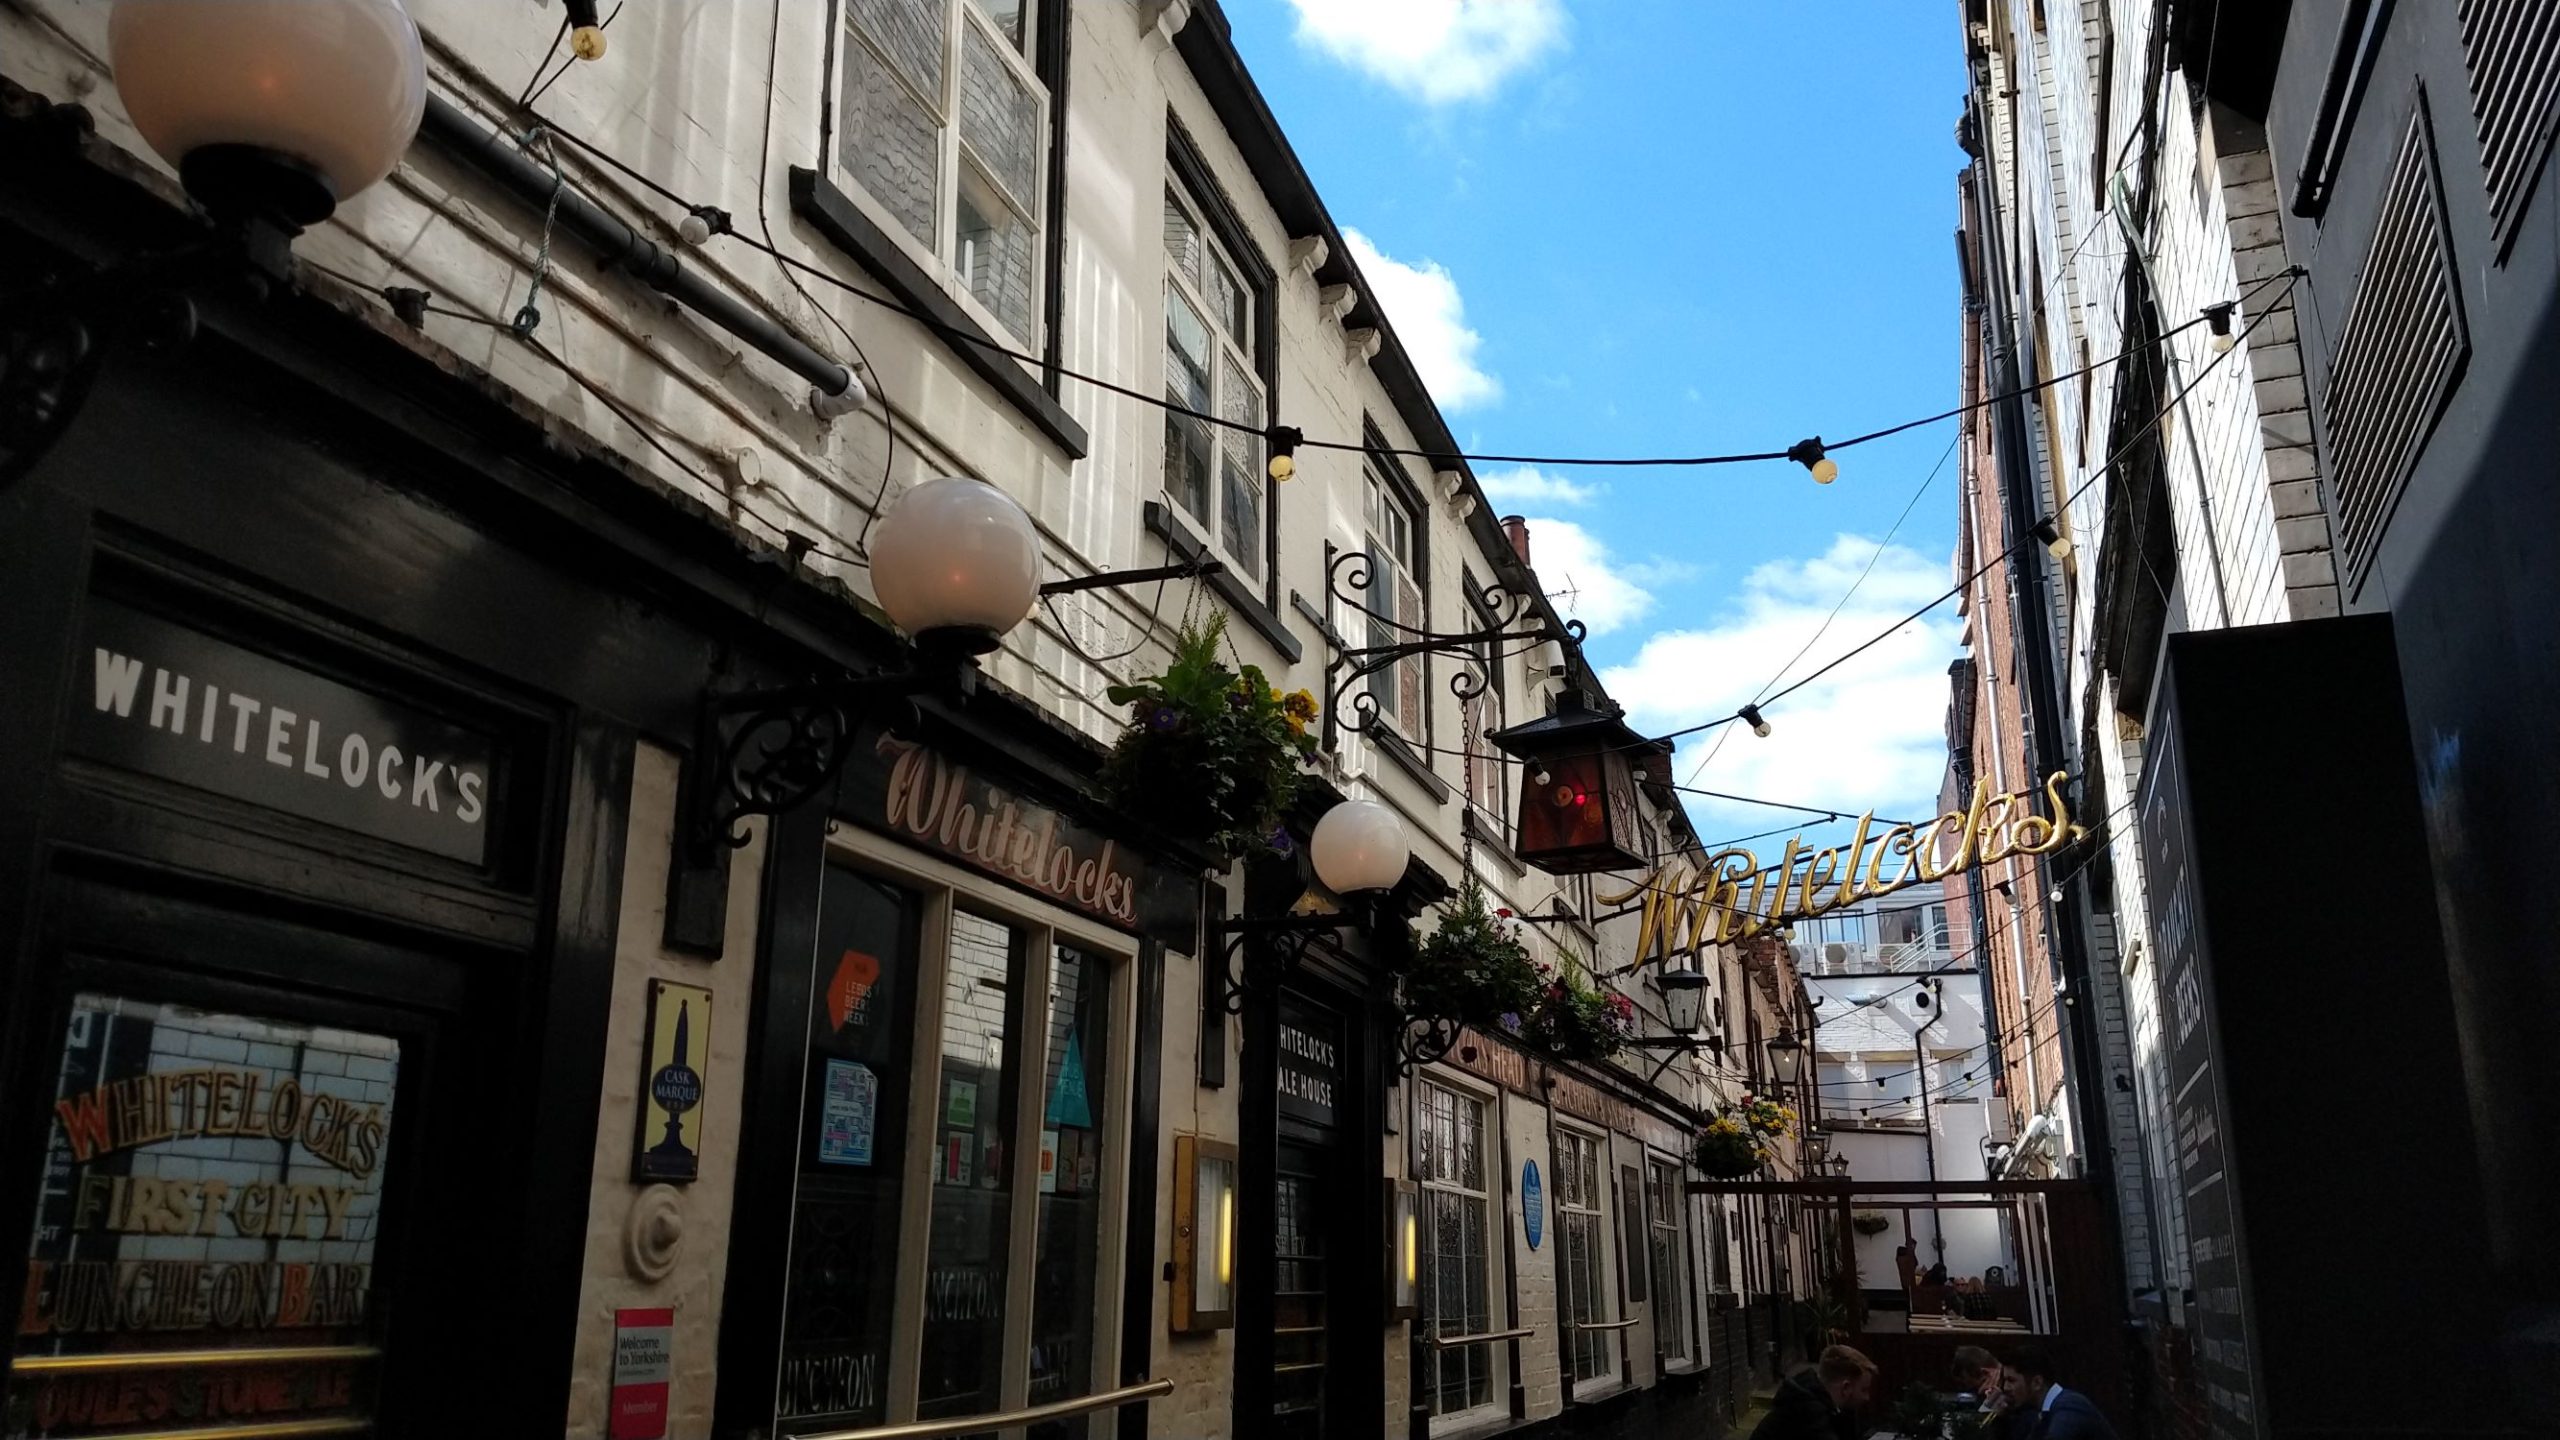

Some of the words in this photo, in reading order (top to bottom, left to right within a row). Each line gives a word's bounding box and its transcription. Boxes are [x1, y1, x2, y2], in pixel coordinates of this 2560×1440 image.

[94, 646, 484, 824] WHITELOCK'S
[875, 736, 1138, 925] Whitelocks
[1597, 770, 2088, 978] Whitelocks
[846, 980, 873, 999] LEEDS
[2175, 952, 2201, 1048] BEERS
[663, 1068, 691, 1085] CASK
[1278, 1066, 1298, 1097] ALE
[1300, 1074, 1333, 1109] HOUSE
[1492, 1040, 1524, 1089] HEAD
[655, 1083, 699, 1101] MARQUE
[73, 1174, 228, 1236] FIRST
[228, 1182, 356, 1239] CITY
[16, 1260, 277, 1337] LUNCHEON
[276, 1261, 371, 1329] BAR
[619, 1352, 629, 1366] to
[630, 1350, 669, 1366] Yorkshire
[620, 1336, 660, 1350] Welcome
[622, 1400, 659, 1416] Member
